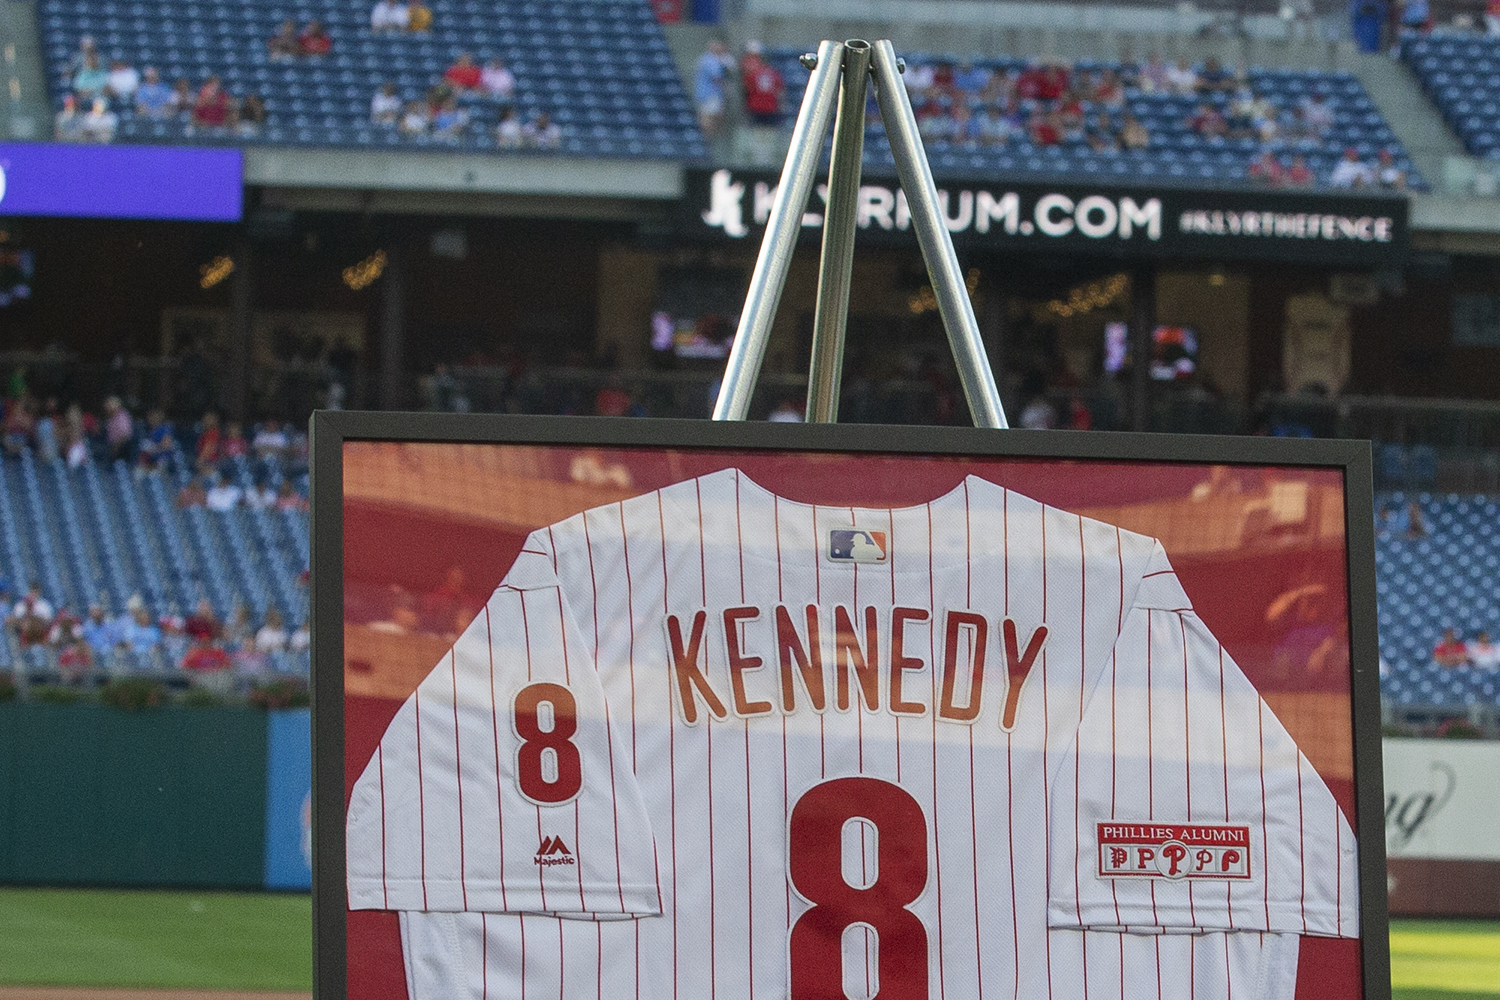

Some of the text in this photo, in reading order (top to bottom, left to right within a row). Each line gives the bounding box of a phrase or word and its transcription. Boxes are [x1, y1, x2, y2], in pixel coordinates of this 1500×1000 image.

[666, 604, 1048, 731] KENNEDY
[514, 682, 582, 803] 8
[533, 856, 575, 868] Majestic
[1103, 826, 1245, 842] PHILLIES ALUMNI
